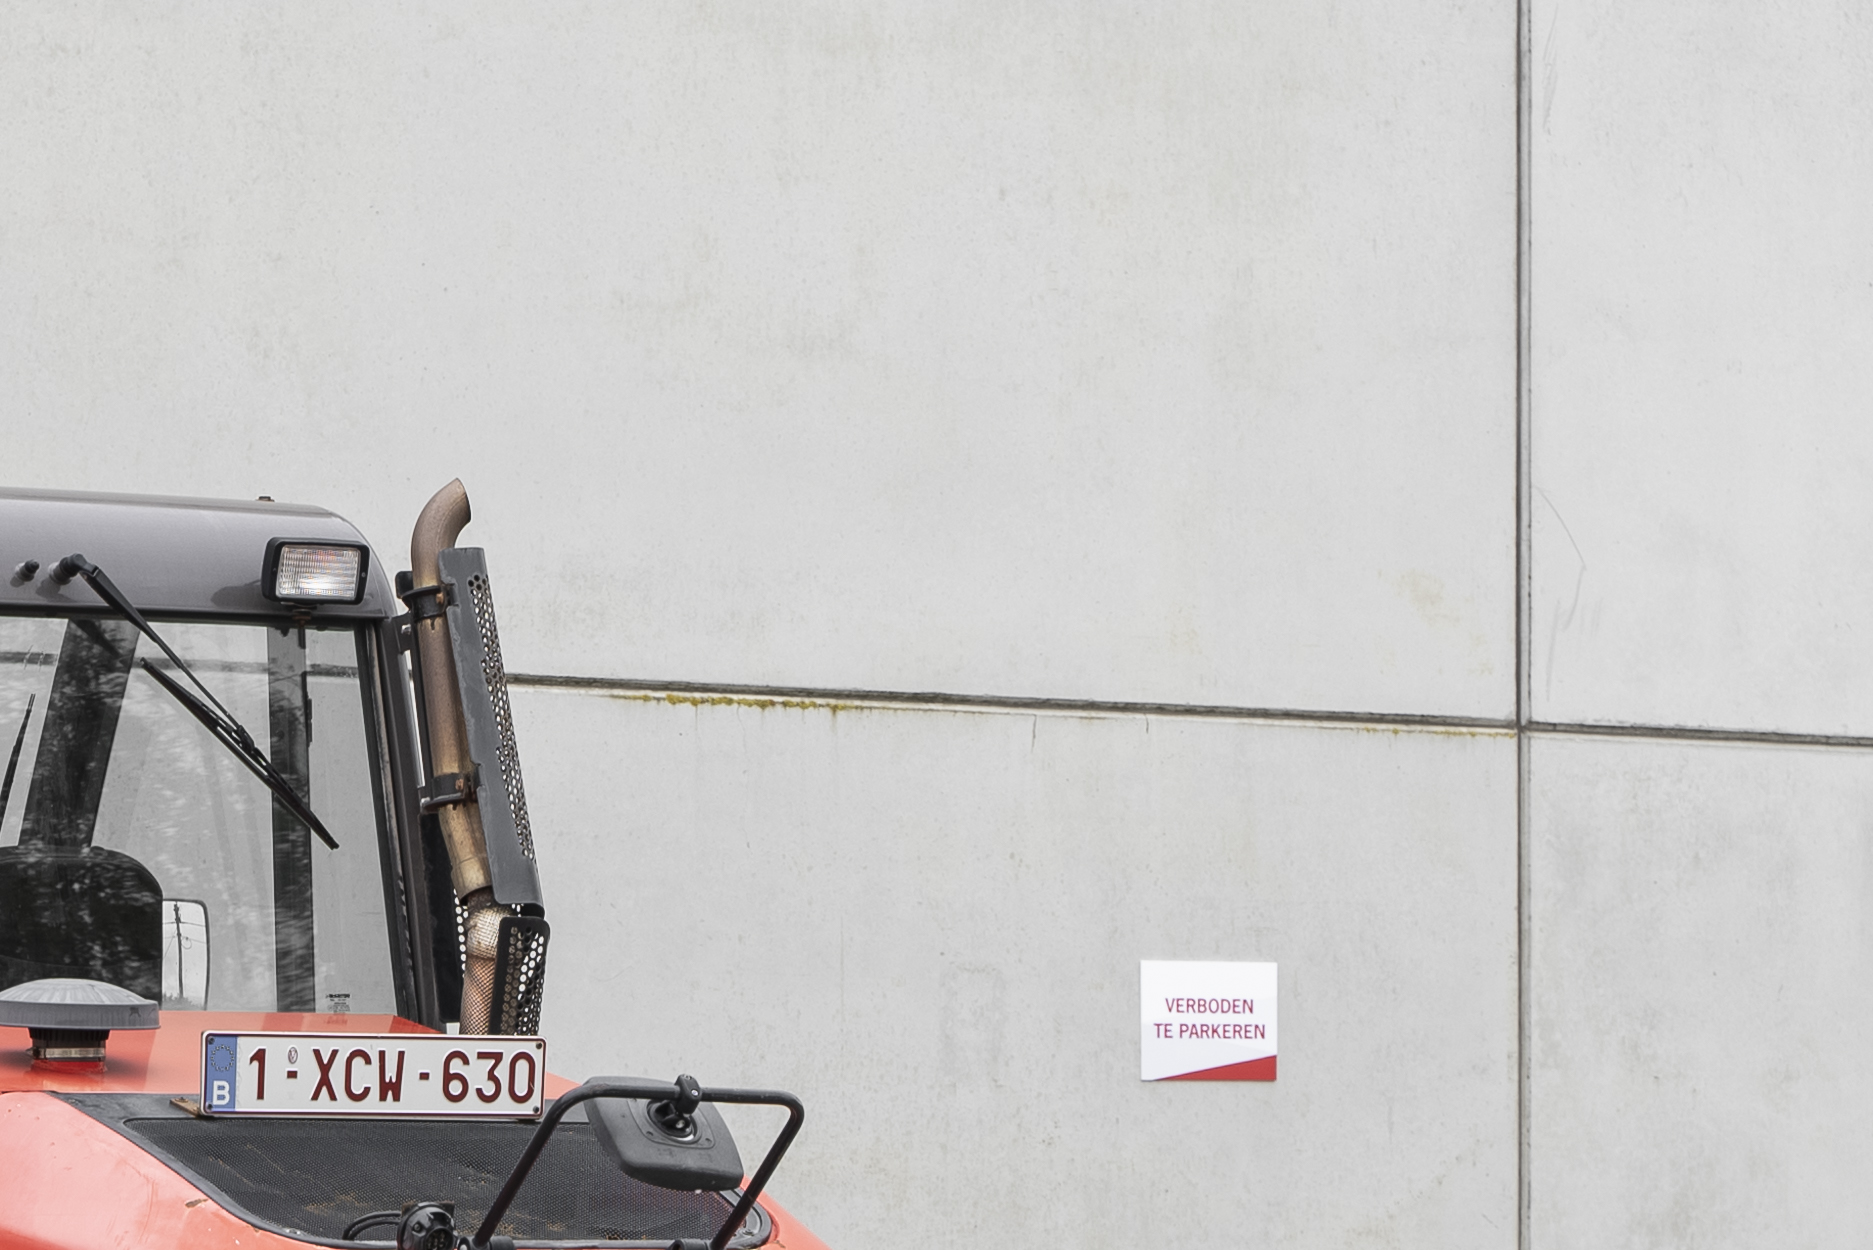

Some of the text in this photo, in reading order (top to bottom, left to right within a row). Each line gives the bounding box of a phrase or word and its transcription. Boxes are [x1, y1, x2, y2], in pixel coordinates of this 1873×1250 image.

[1164, 998, 1254, 1014] VERBODEN
[1153, 1023, 1266, 1040] TE PARKEREN
[248, 1047, 536, 1104] 1-XCW-630
[212, 1080, 230, 1106] B
